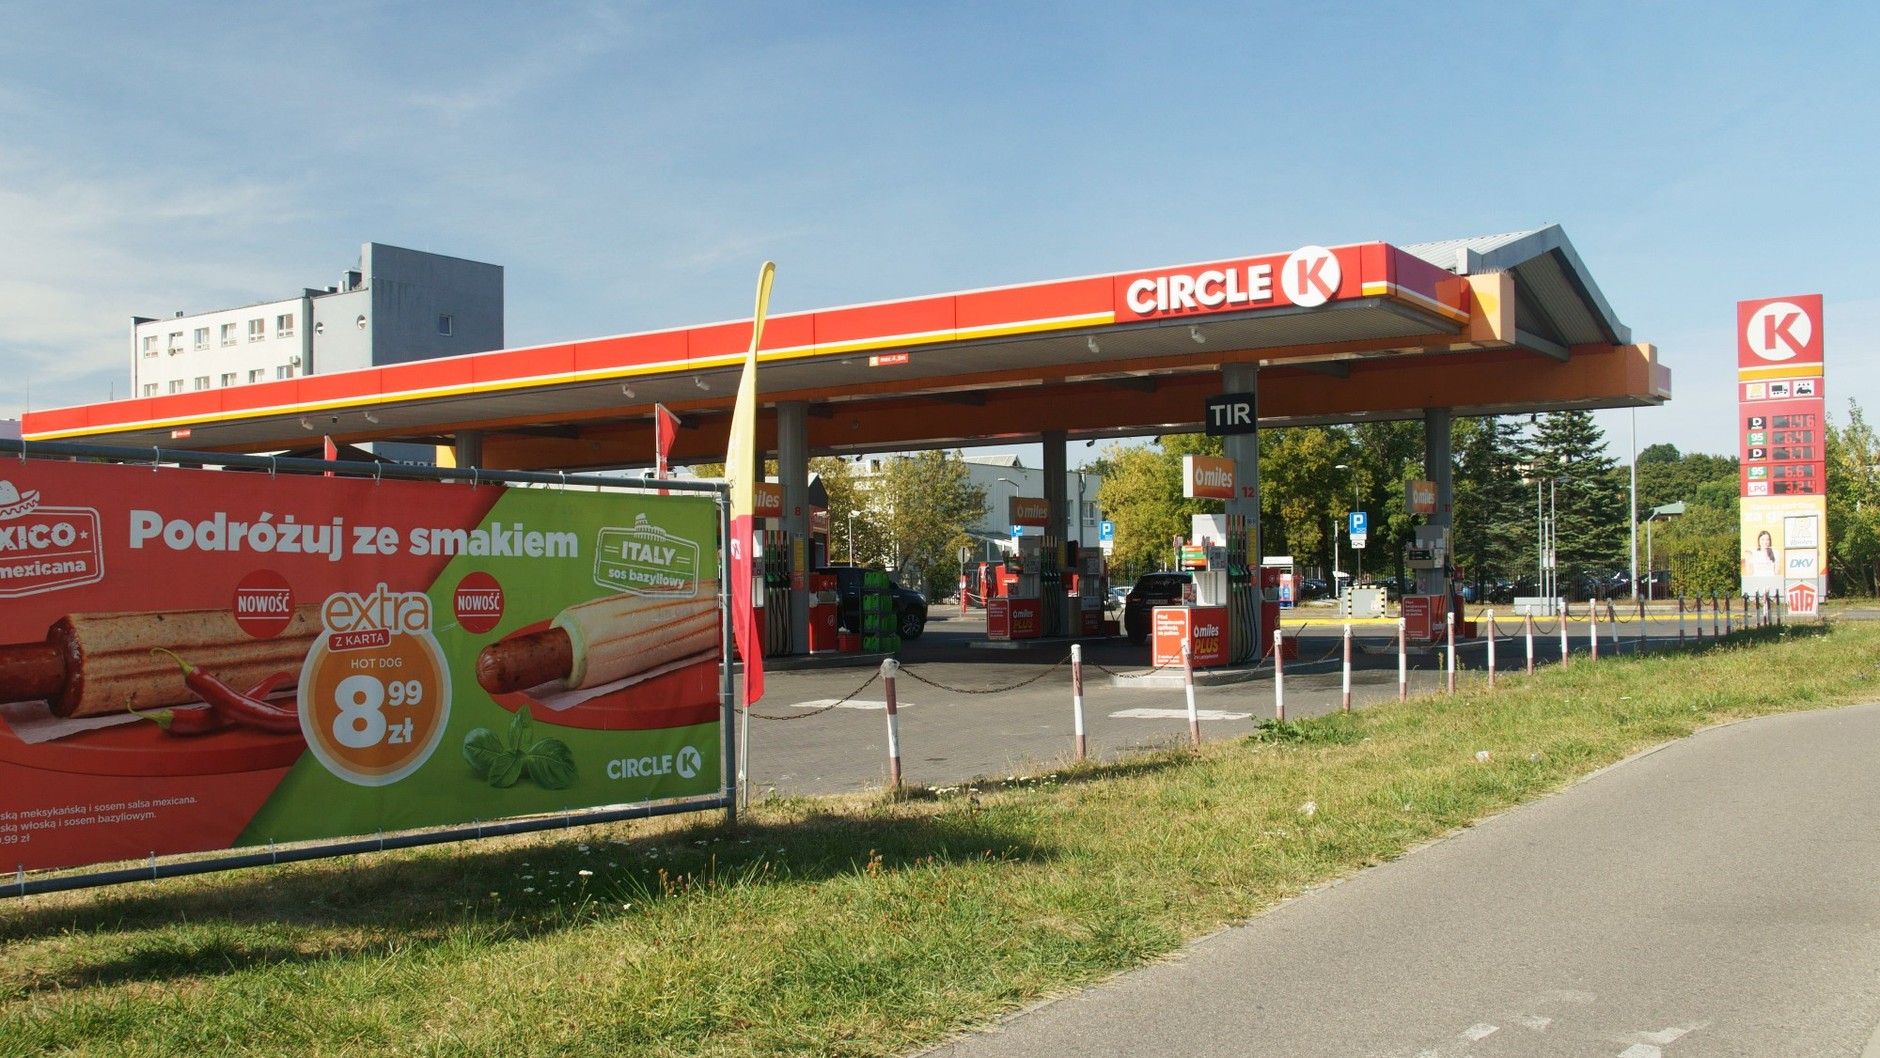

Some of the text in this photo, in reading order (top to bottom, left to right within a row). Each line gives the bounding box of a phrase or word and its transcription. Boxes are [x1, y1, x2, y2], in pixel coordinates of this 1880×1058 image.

[1126, 250, 1340, 314] CIRCLE K
[1757, 307, 1808, 359] K
[1210, 403, 1252, 427] TIR
[1750, 433, 1764, 442] 95
[1204, 466, 1233, 488] miles
[1750, 467, 1764, 476] 95
[1241, 486, 1256, 498] 12
[1024, 504, 1048, 519] miles
[1353, 514, 1363, 527] P
[129, 509, 578, 562] Podróżuj ze smakiem
[1102, 523, 1111, 536] P
[621, 541, 677, 566] ITALY
[0, 560, 87, 579] mexicana
[1790, 559, 1813, 569] DKV
[608, 568, 685, 590] sos bazyliowy
[237, 592, 290, 613] NOWOŚĆ
[325, 586, 430, 632] extra
[458, 593, 500, 611] NOWOŚĆ
[335, 633, 385, 647] Z KARTĄ
[1200, 625, 1219, 637] miles
[1194, 638, 1219, 654] PLUS
[351, 658, 403, 669] HOT DOG
[333, 674, 423, 749] 8 99
[388, 717, 414, 744] zł
[606, 748, 701, 780] CIRCLE K
[20, 804, 87, 818] meksykańską
[94, 802, 126, 812] sosem
[127, 799, 151, 809] salsa
[152, 796, 198, 808] mexicana.
[20, 819, 57, 831] włoską
[64, 816, 96, 827] sosem
[97, 811, 157, 823] bazyliowym.
